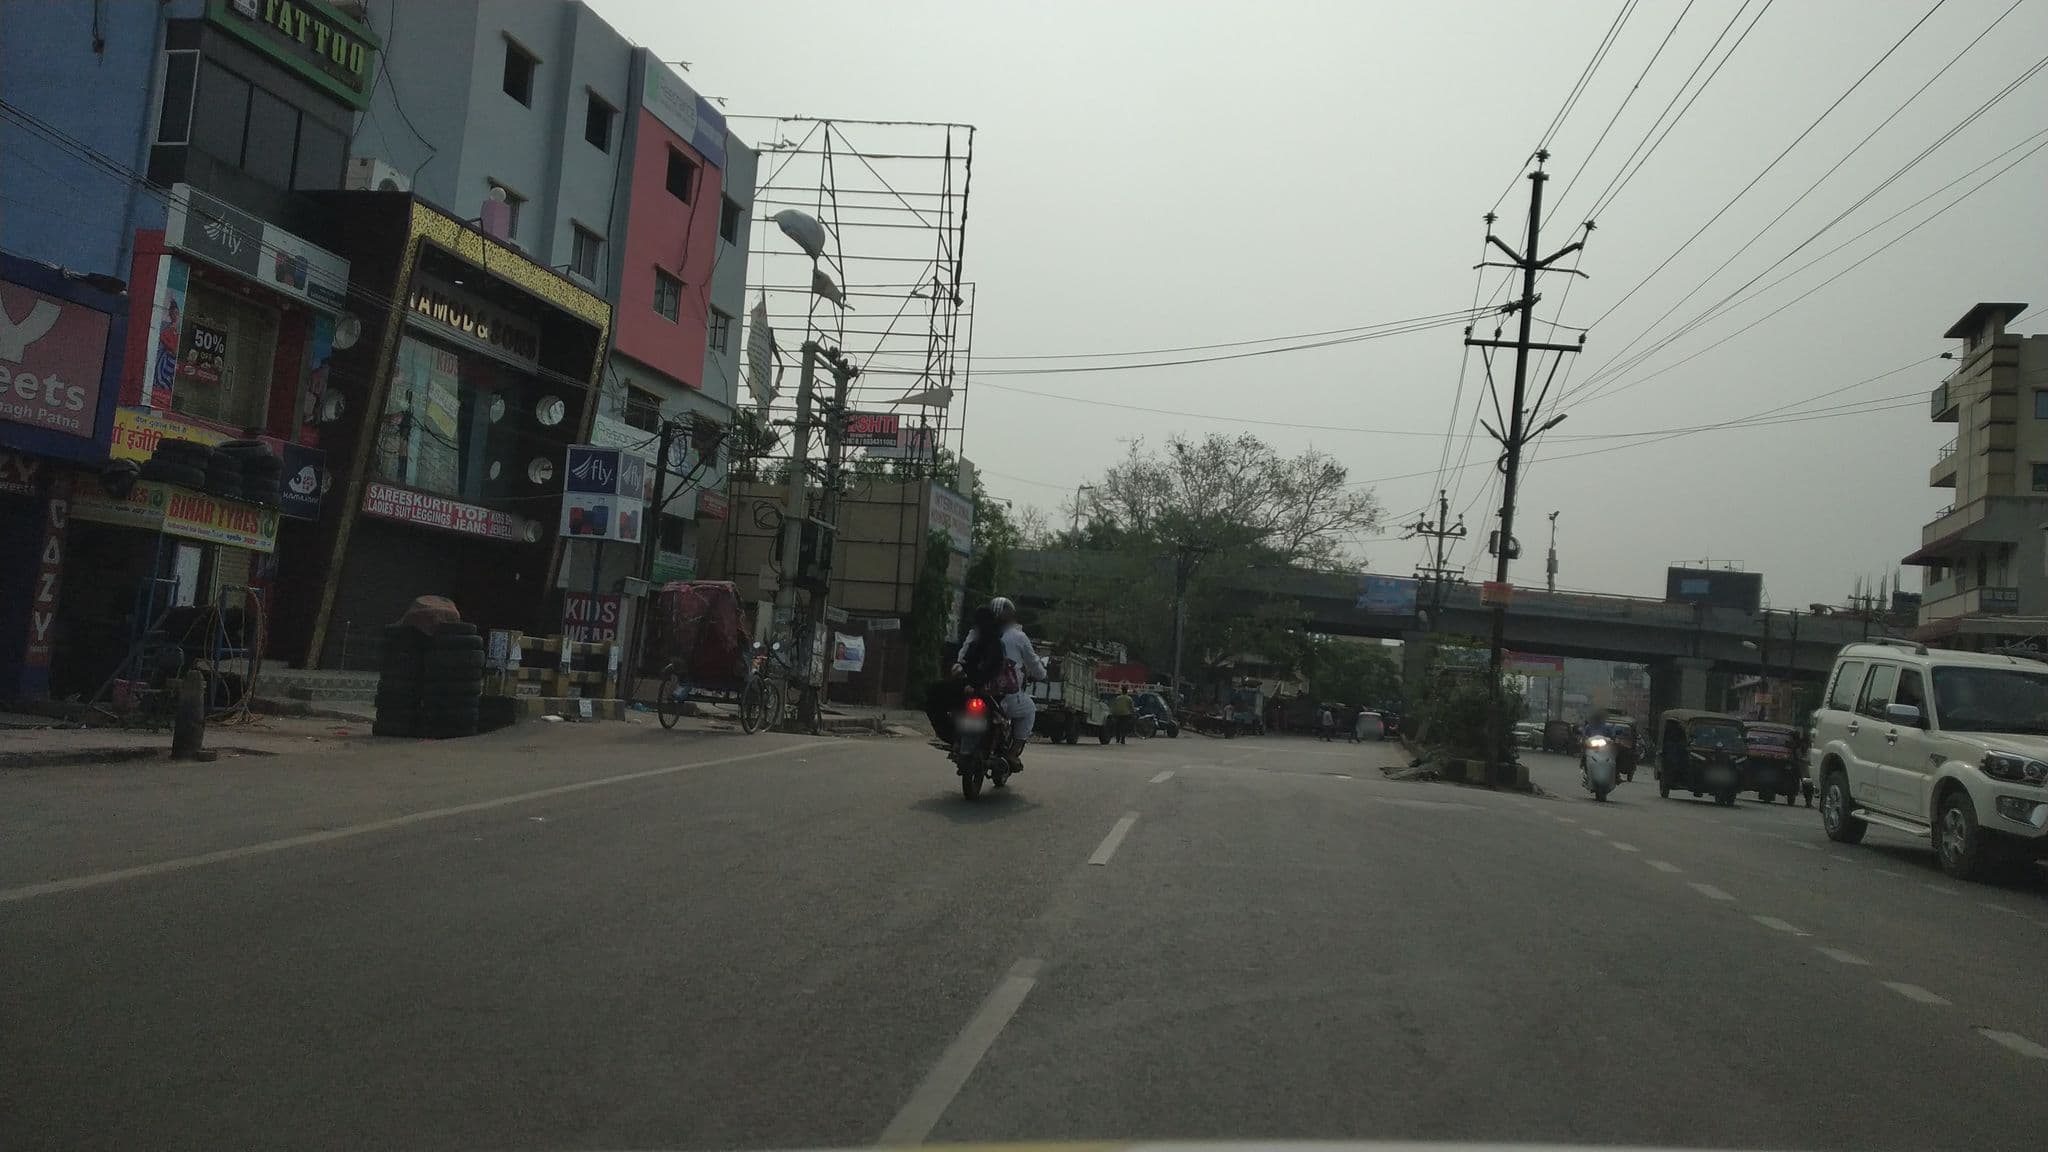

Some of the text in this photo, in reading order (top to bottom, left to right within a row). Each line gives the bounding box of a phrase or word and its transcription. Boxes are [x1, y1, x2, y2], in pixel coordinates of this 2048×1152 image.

[264, 0, 364, 74] TATTOO
[195, 328, 224, 354] 50%
[39, 407, 81, 430] Patna
[591, 458, 614, 486] fly.
[367, 498, 393, 515] LADIES
[394, 504, 411, 519] SUIT
[411, 507, 451, 525] LEGGINGS
[453, 518, 487, 535] JEANS
[369, 486, 412, 506] SAREES
[413, 490, 452, 513] KURTI
[455, 503, 488, 522] TOP
[565, 598, 617, 624] KIDS
